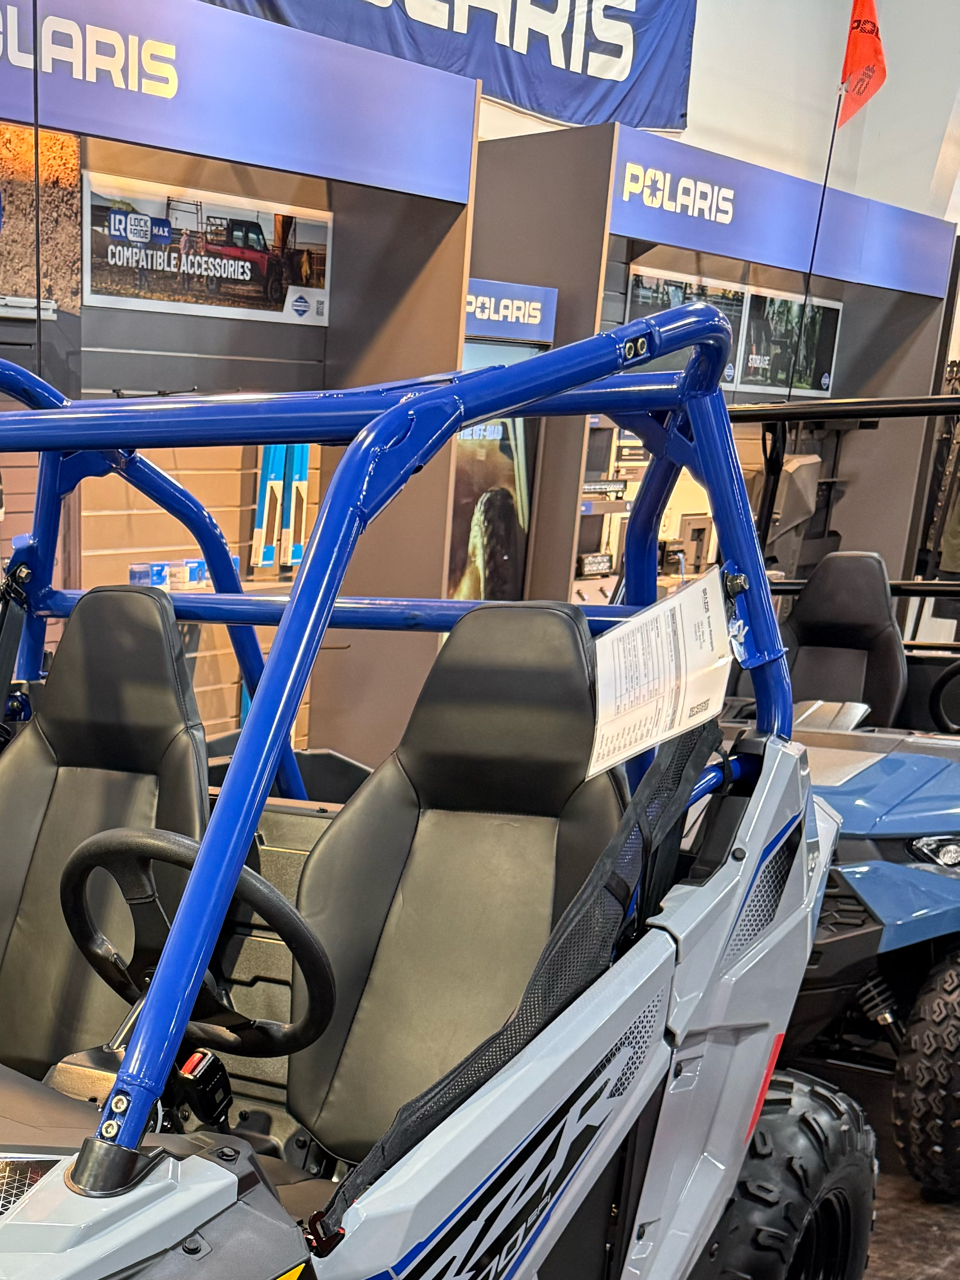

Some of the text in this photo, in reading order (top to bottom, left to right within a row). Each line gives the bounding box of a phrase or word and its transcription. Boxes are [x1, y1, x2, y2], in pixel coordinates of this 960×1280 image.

[622, 162, 734, 225] POLARIS
[129, 216, 149, 229] LOCK
[152, 225, 169, 237] MAX
[107, 244, 251, 281] COMPATIBLE ACCESSORIES
[466, 294, 541, 324] POLARIS
[748, 354, 770, 369] STORAGE
